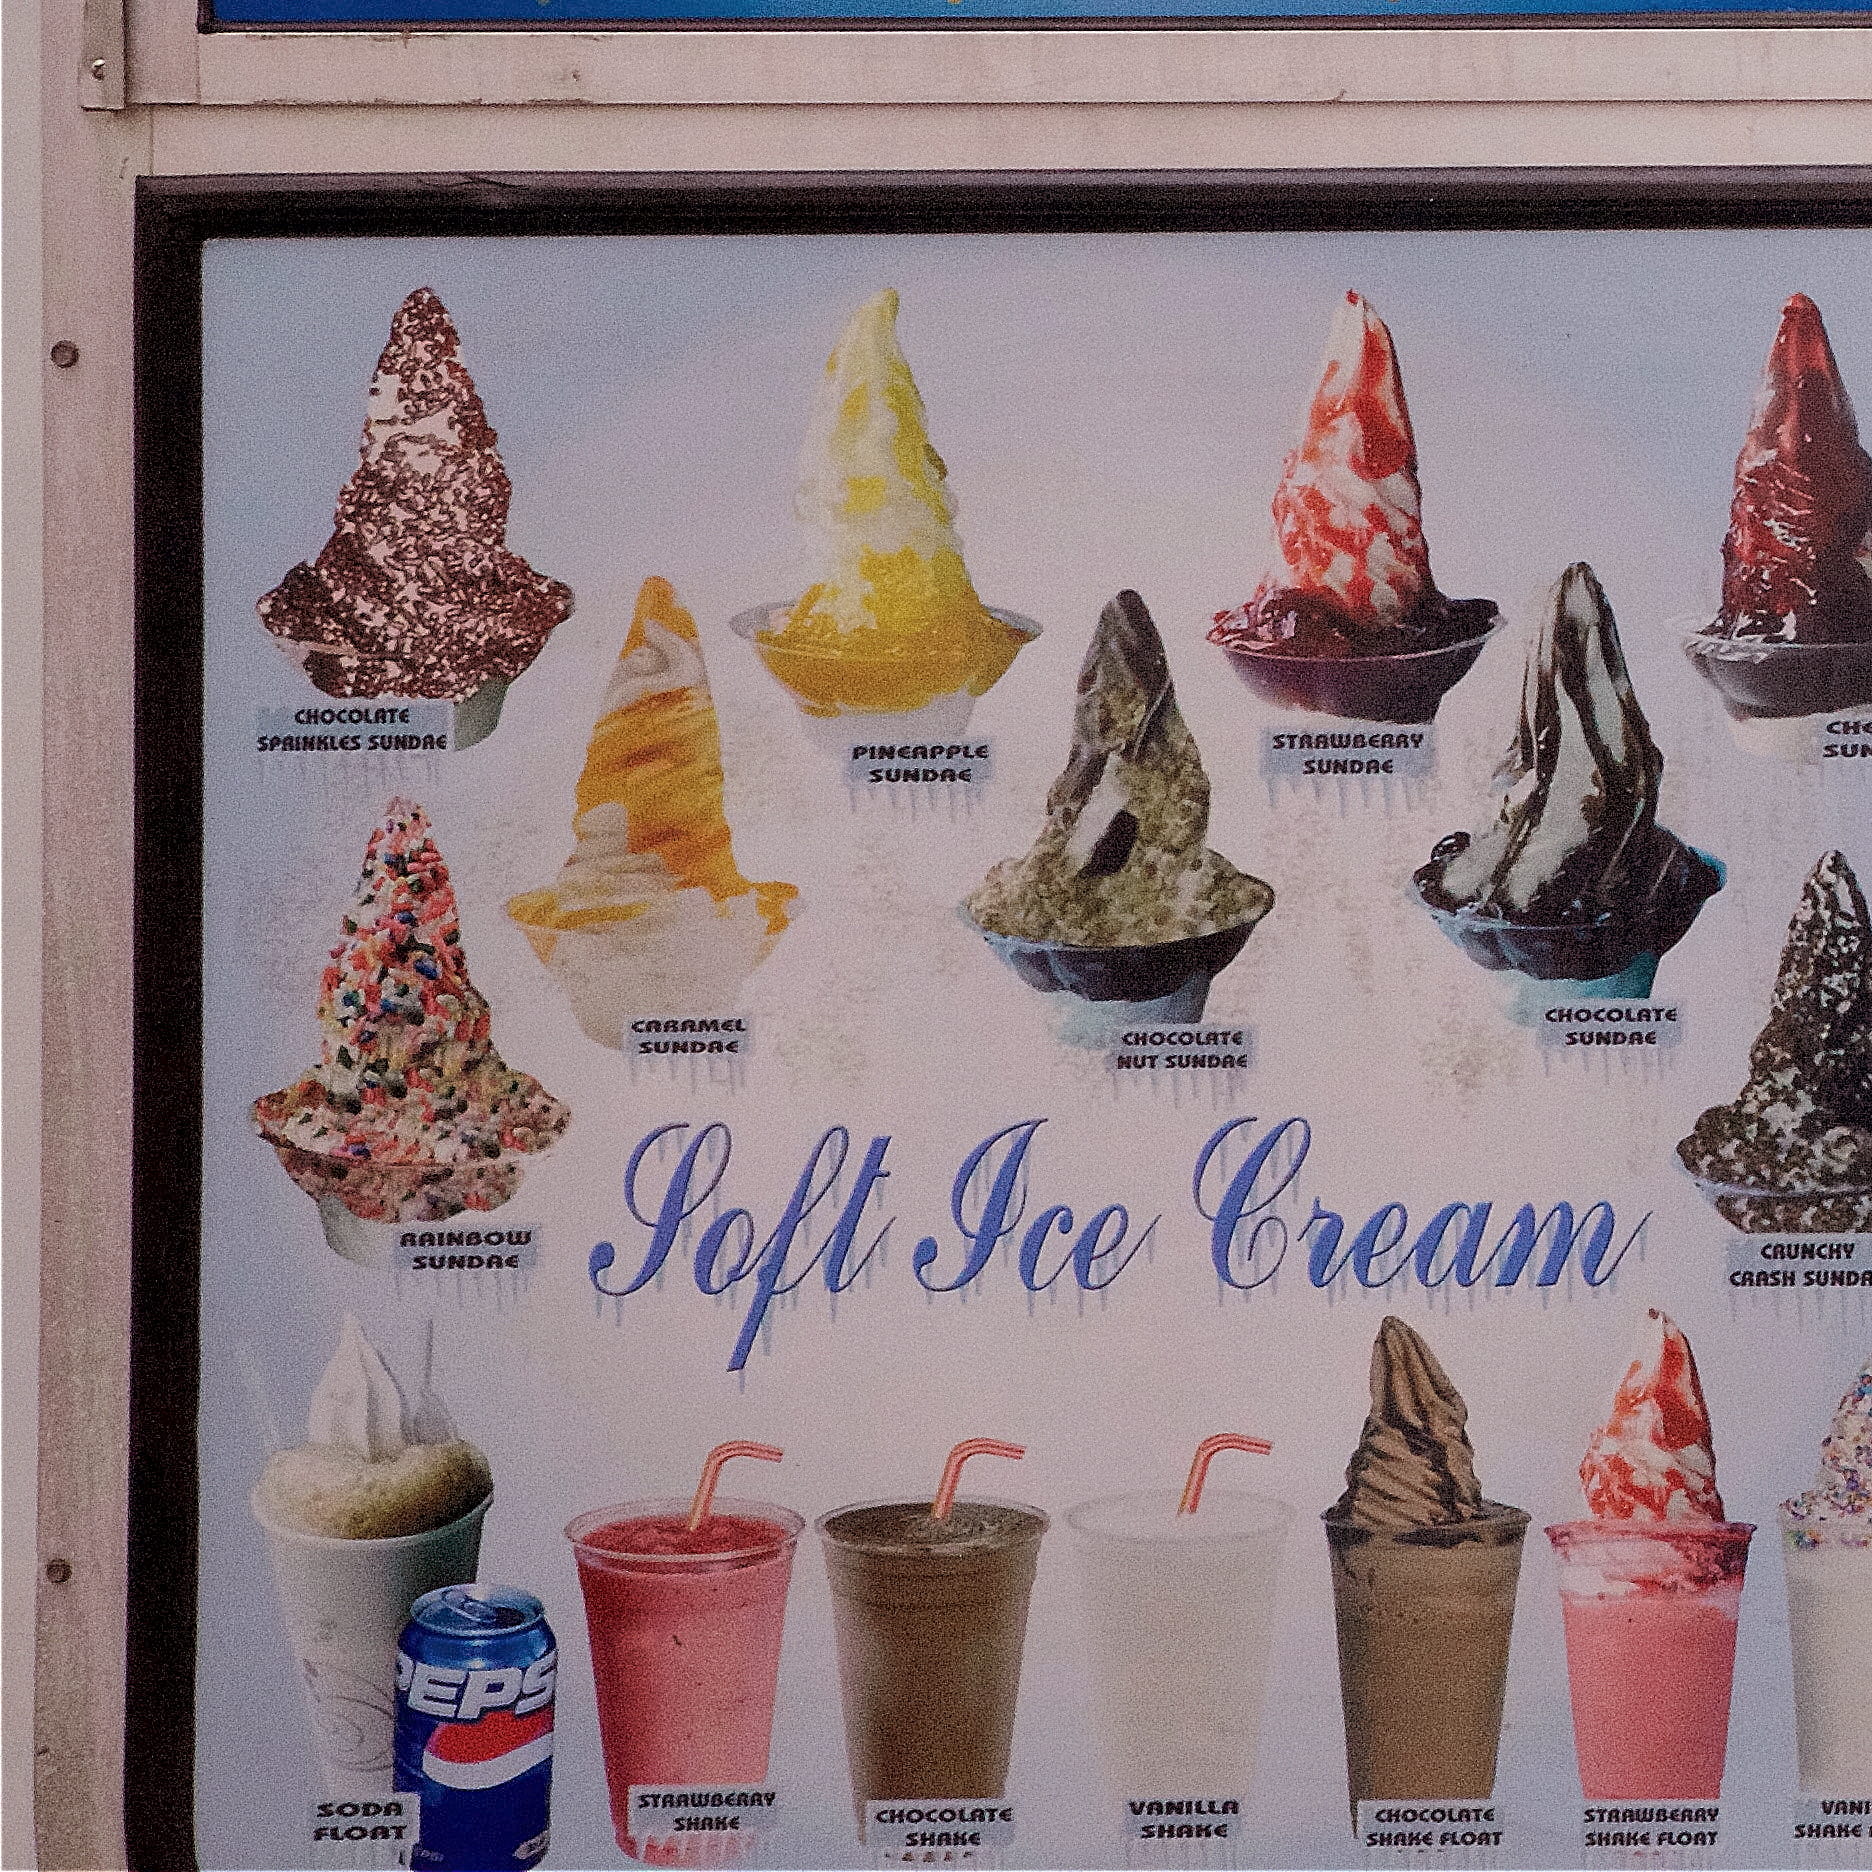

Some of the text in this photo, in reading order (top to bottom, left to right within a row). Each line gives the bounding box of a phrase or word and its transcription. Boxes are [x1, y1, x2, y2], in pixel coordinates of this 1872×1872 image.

[295, 707, 410, 725] CHOCOLATE
[258, 733, 448, 752] SPRINKLES SUNDAE
[1273, 733, 1424, 750] STRAWBERRY
[853, 744, 988, 760] PINEAPPLE
[1303, 758, 1394, 775] SUNDAE
[869, 767, 972, 784] SUNDAE
[1545, 1007, 1678, 1024] CHOCOLATE
[632, 1017, 746, 1034] CARAMEL
[1122, 1031, 1243, 1048] CHOCOLATE
[1566, 1029, 1657, 1046] SUNDAE
[639, 1039, 739, 1055] SUNDAE
[1117, 1053, 1248, 1070] NUT SUNDAE
[400, 1231, 531, 1247] RAINBOW
[588, 1116, 1655, 1373] Soft Ice Cream
[1761, 1244, 1854, 1260] CRUNCHY
[413, 1254, 519, 1270] SUNDAE
[1730, 1270, 1797, 1287] CRASH
[639, 1792, 775, 1809] STRAWBERRY
[1130, 1800, 1240, 1816] VANILLA
[317, 1801, 402, 1818] SODA
[1375, 1808, 1495, 1823] CHOCOLATE
[674, 1815, 740, 1831] SHAKE
[1141, 1823, 1228, 1838] SHAKE
[312, 1824, 407, 1842] FLOAT
[1366, 1831, 1502, 1847] SHAKE FLOAT
